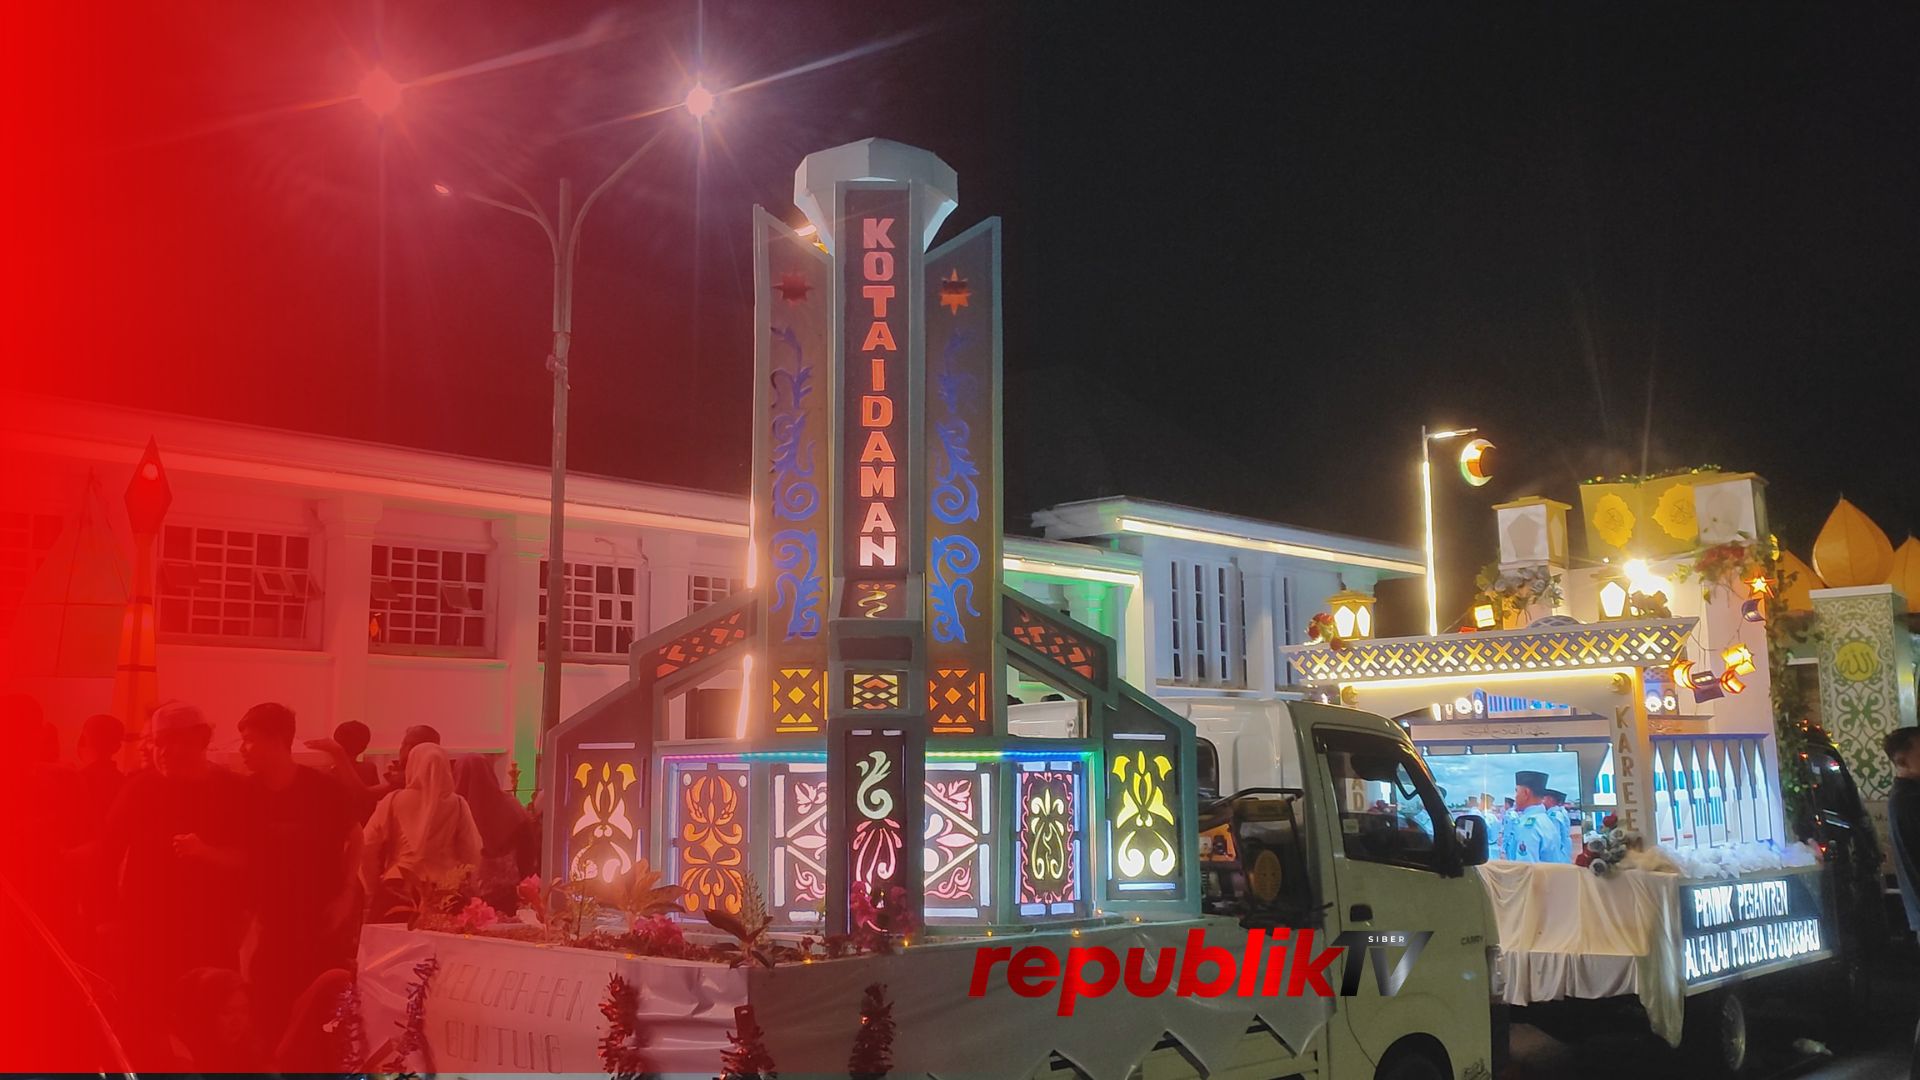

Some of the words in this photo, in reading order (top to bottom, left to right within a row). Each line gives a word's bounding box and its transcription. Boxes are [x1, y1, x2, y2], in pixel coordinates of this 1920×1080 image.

[1736, 880, 1788, 920] PESANTREN
[1685, 938, 1701, 980] AL
[1700, 930, 1730, 975] FALAH
[1731, 925, 1768, 968] PUTERA
[1766, 918, 1820, 959] BANJARBARU
